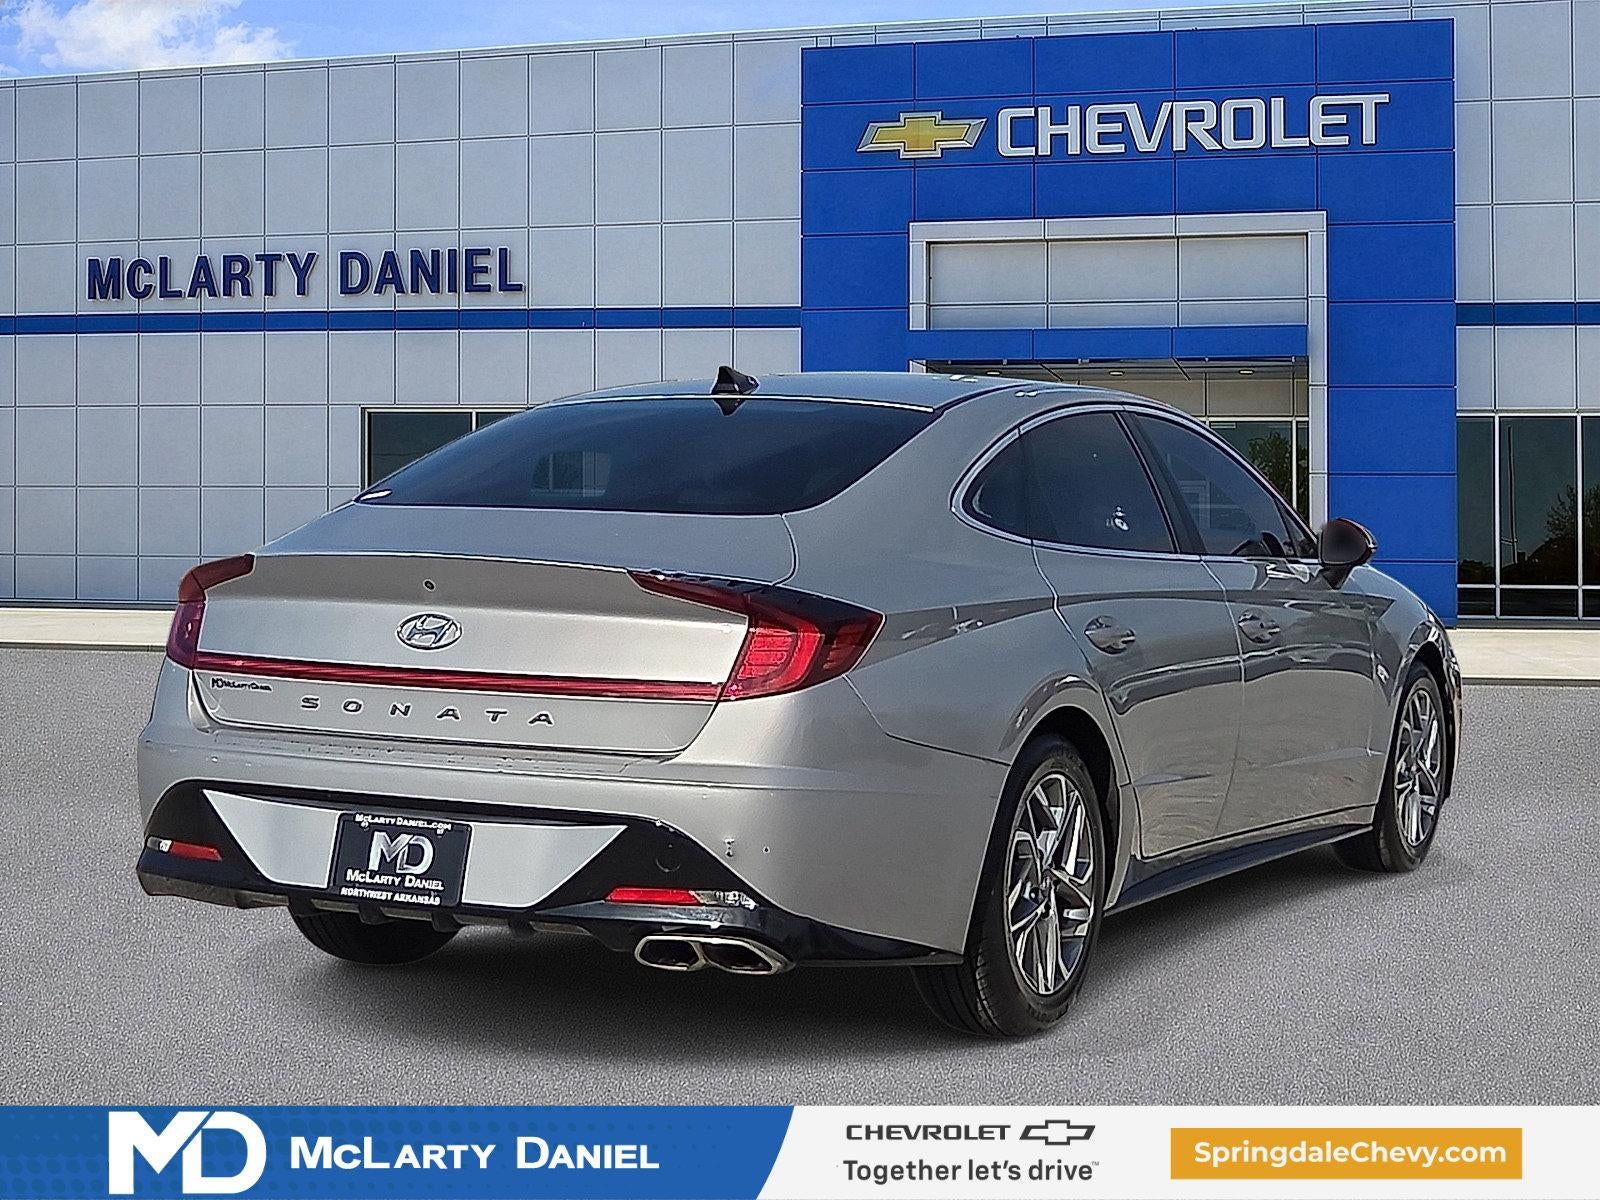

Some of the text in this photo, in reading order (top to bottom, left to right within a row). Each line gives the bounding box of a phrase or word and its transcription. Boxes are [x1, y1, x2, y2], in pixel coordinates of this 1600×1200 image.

[996, 93, 1390, 158] CHEVROLET
[86, 246, 525, 301] MCLARTY DANIEL
[300, 696, 554, 727] SONATA
[368, 831, 434, 875] MD
[340, 886, 441, 905] NORTHWEST ARKANSAS
[404, 875, 444, 890] DANIEL
